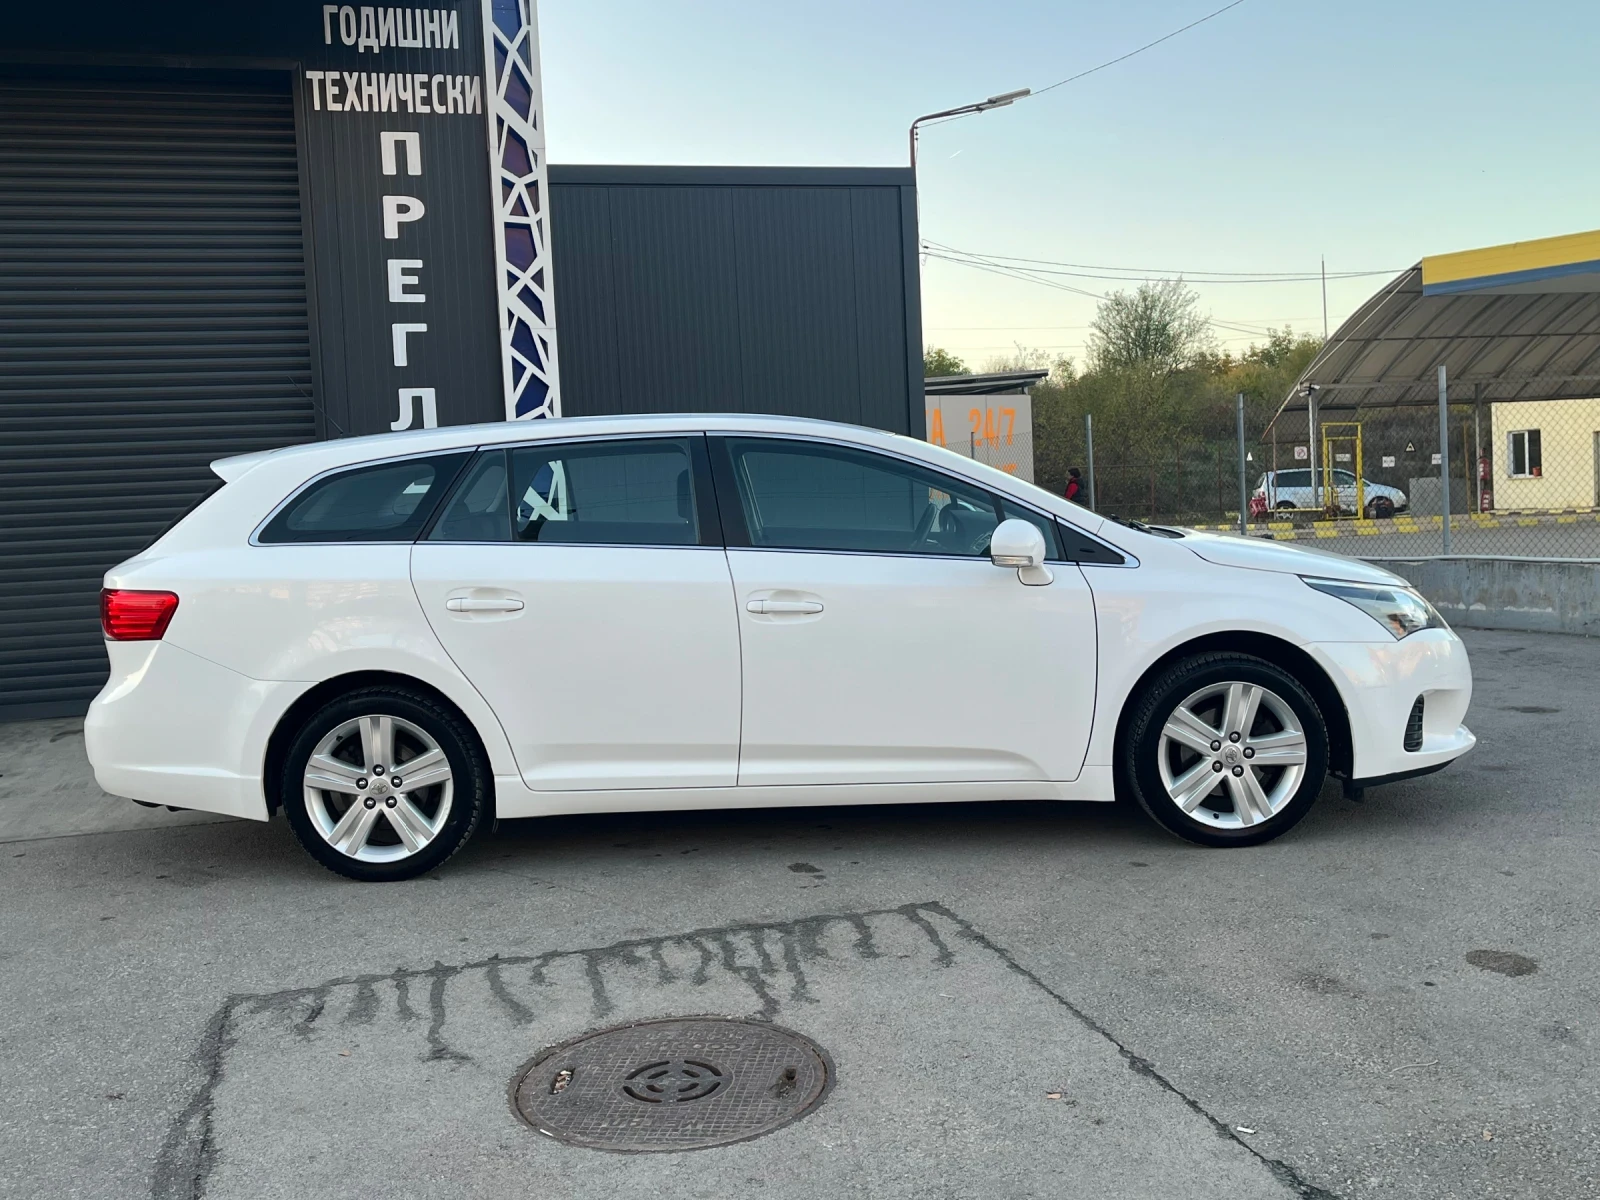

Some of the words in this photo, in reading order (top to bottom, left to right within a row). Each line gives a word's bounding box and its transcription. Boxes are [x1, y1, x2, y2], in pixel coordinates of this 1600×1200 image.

[323, 5, 459, 53] ГОДИШНИ
[306, 71, 482, 115] ТЕХНИЧЕСКИ
[380, 131, 437, 431] ПРЕГЛ
[968, 406, 1017, 449] 24/7
